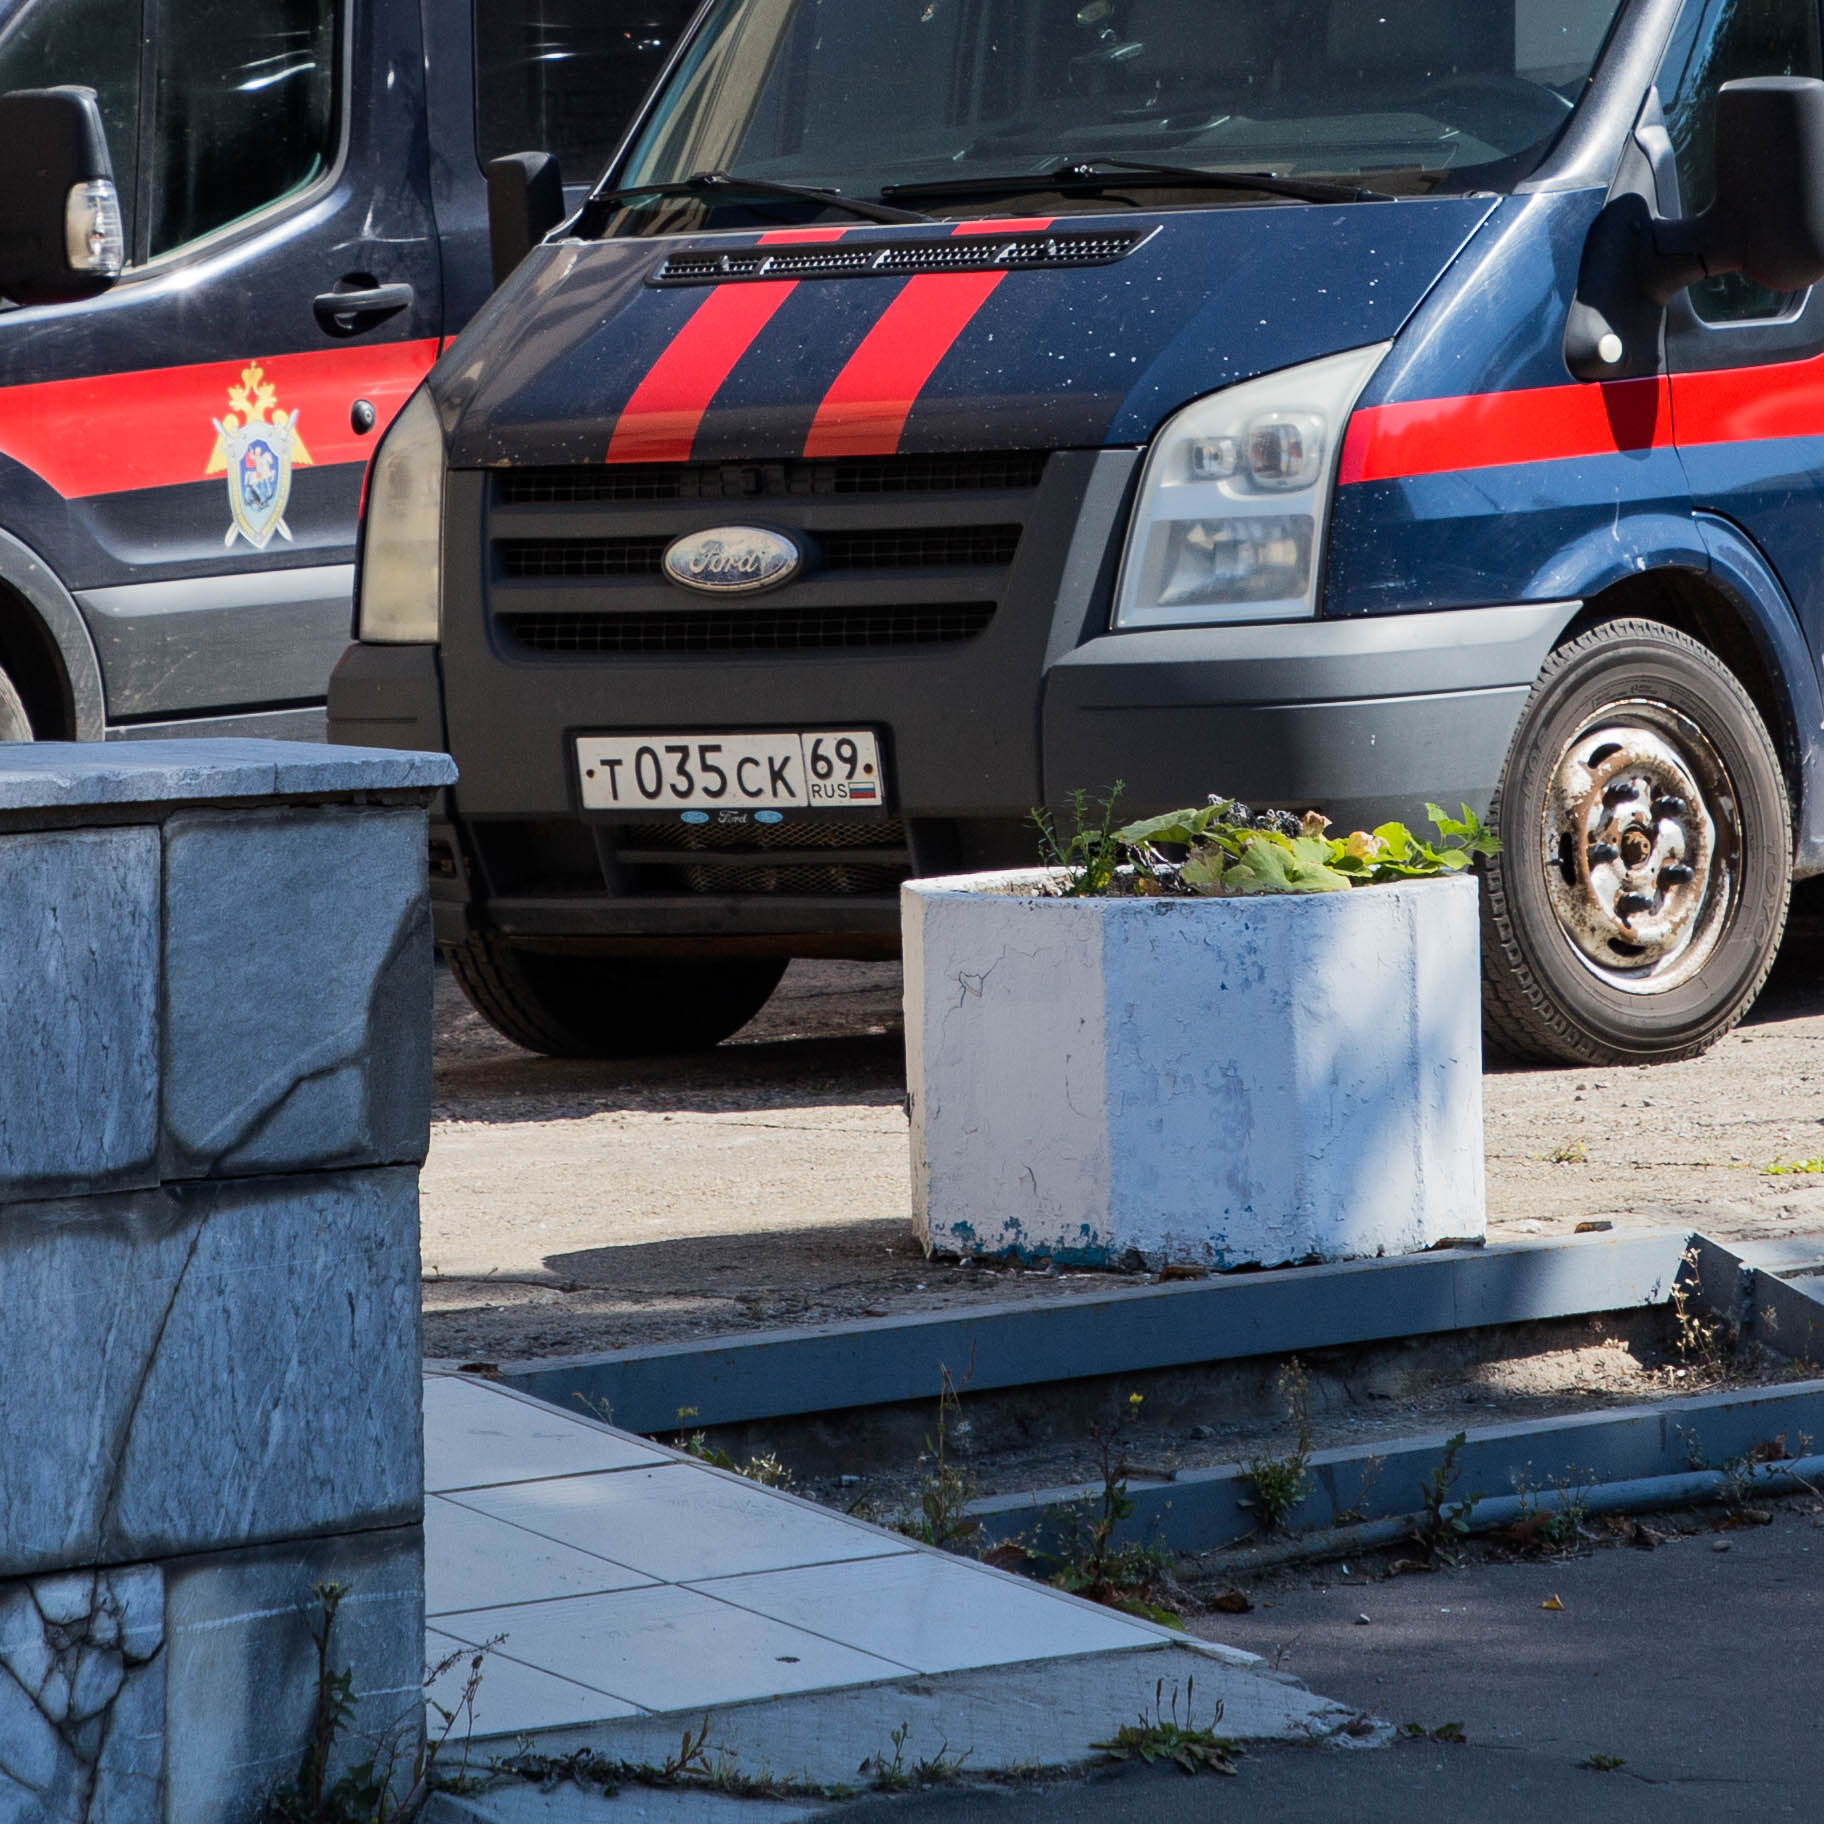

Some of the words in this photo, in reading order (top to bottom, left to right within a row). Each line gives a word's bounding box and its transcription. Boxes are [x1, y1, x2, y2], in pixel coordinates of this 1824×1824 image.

[690, 539, 759, 574] Ford
[599, 743, 797, 801] Т035СК
[810, 737, 859, 781] 69
[811, 783, 848, 799] RUS
